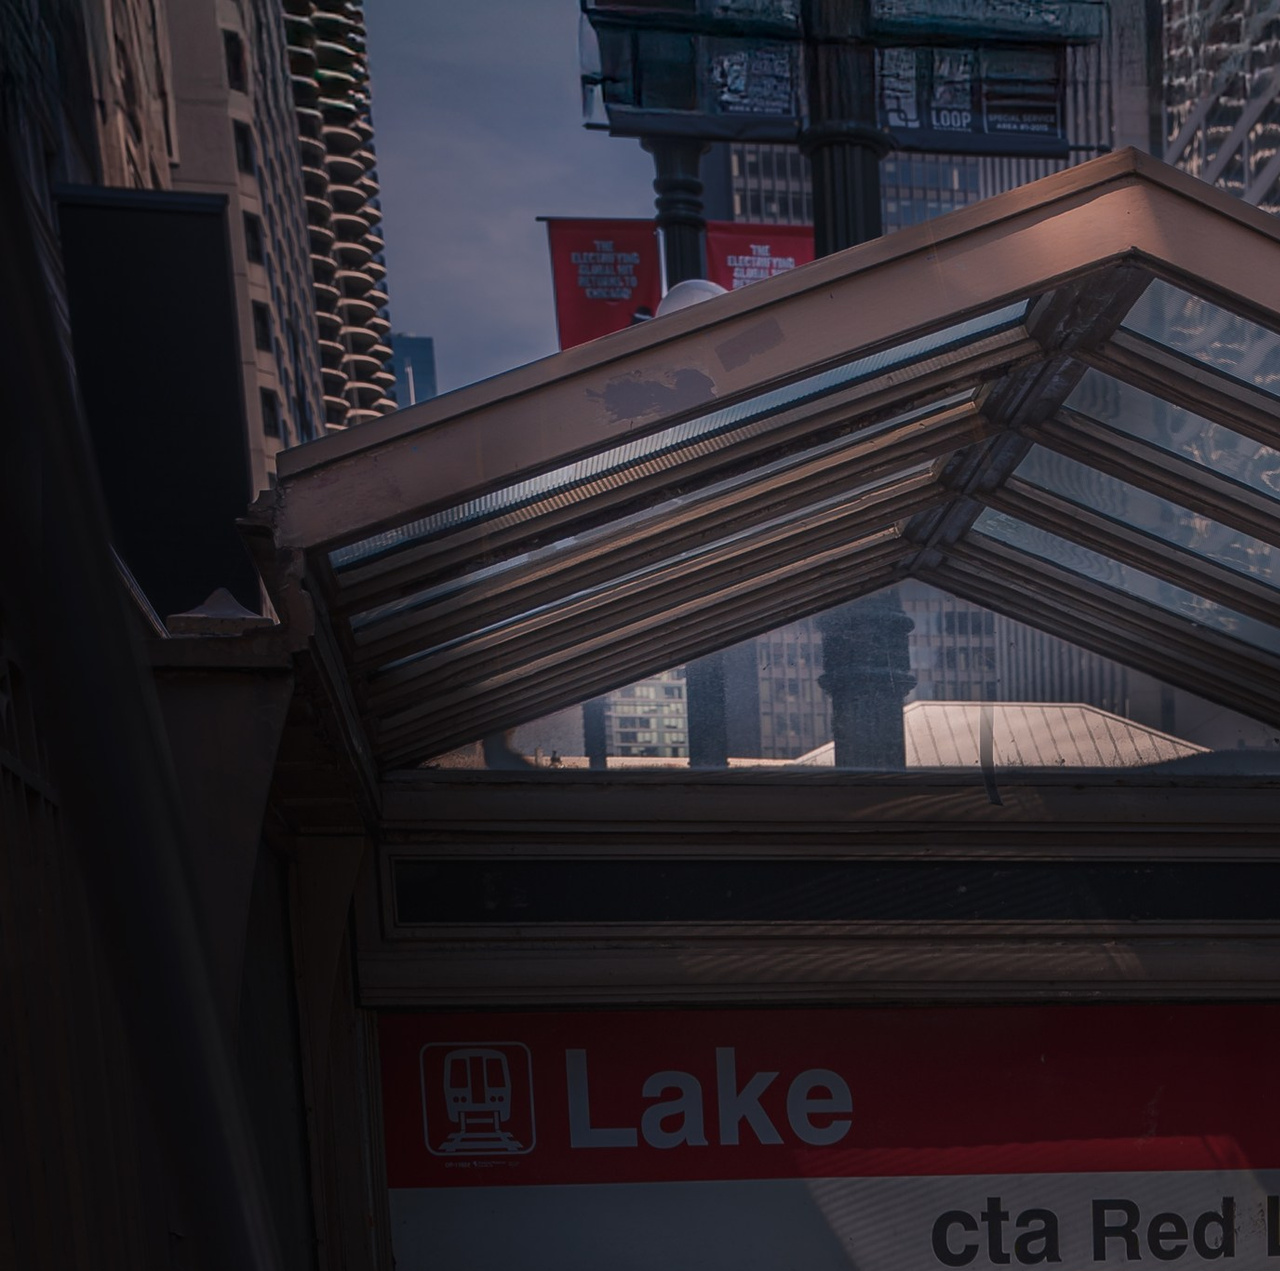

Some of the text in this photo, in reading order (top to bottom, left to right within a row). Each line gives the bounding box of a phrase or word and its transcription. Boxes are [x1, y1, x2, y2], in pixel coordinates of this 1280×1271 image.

[931, 109, 972, 128] LOOP
[988, 113, 1056, 123] SPECIAL SERVICE
[593, 240, 614, 252] THE
[749, 244, 770, 256] THE
[571, 251, 641, 265] ELECTRIFYING
[726, 255, 796, 269] ELECTRIFYING
[578, 264, 634, 276] GLOBAL HIT
[577, 276, 639, 288] RETURNS TO
[564, 1046, 855, 1150] Lake
[930, 1196, 1062, 1267] cta
[1091, 1195, 1236, 1262] Red
